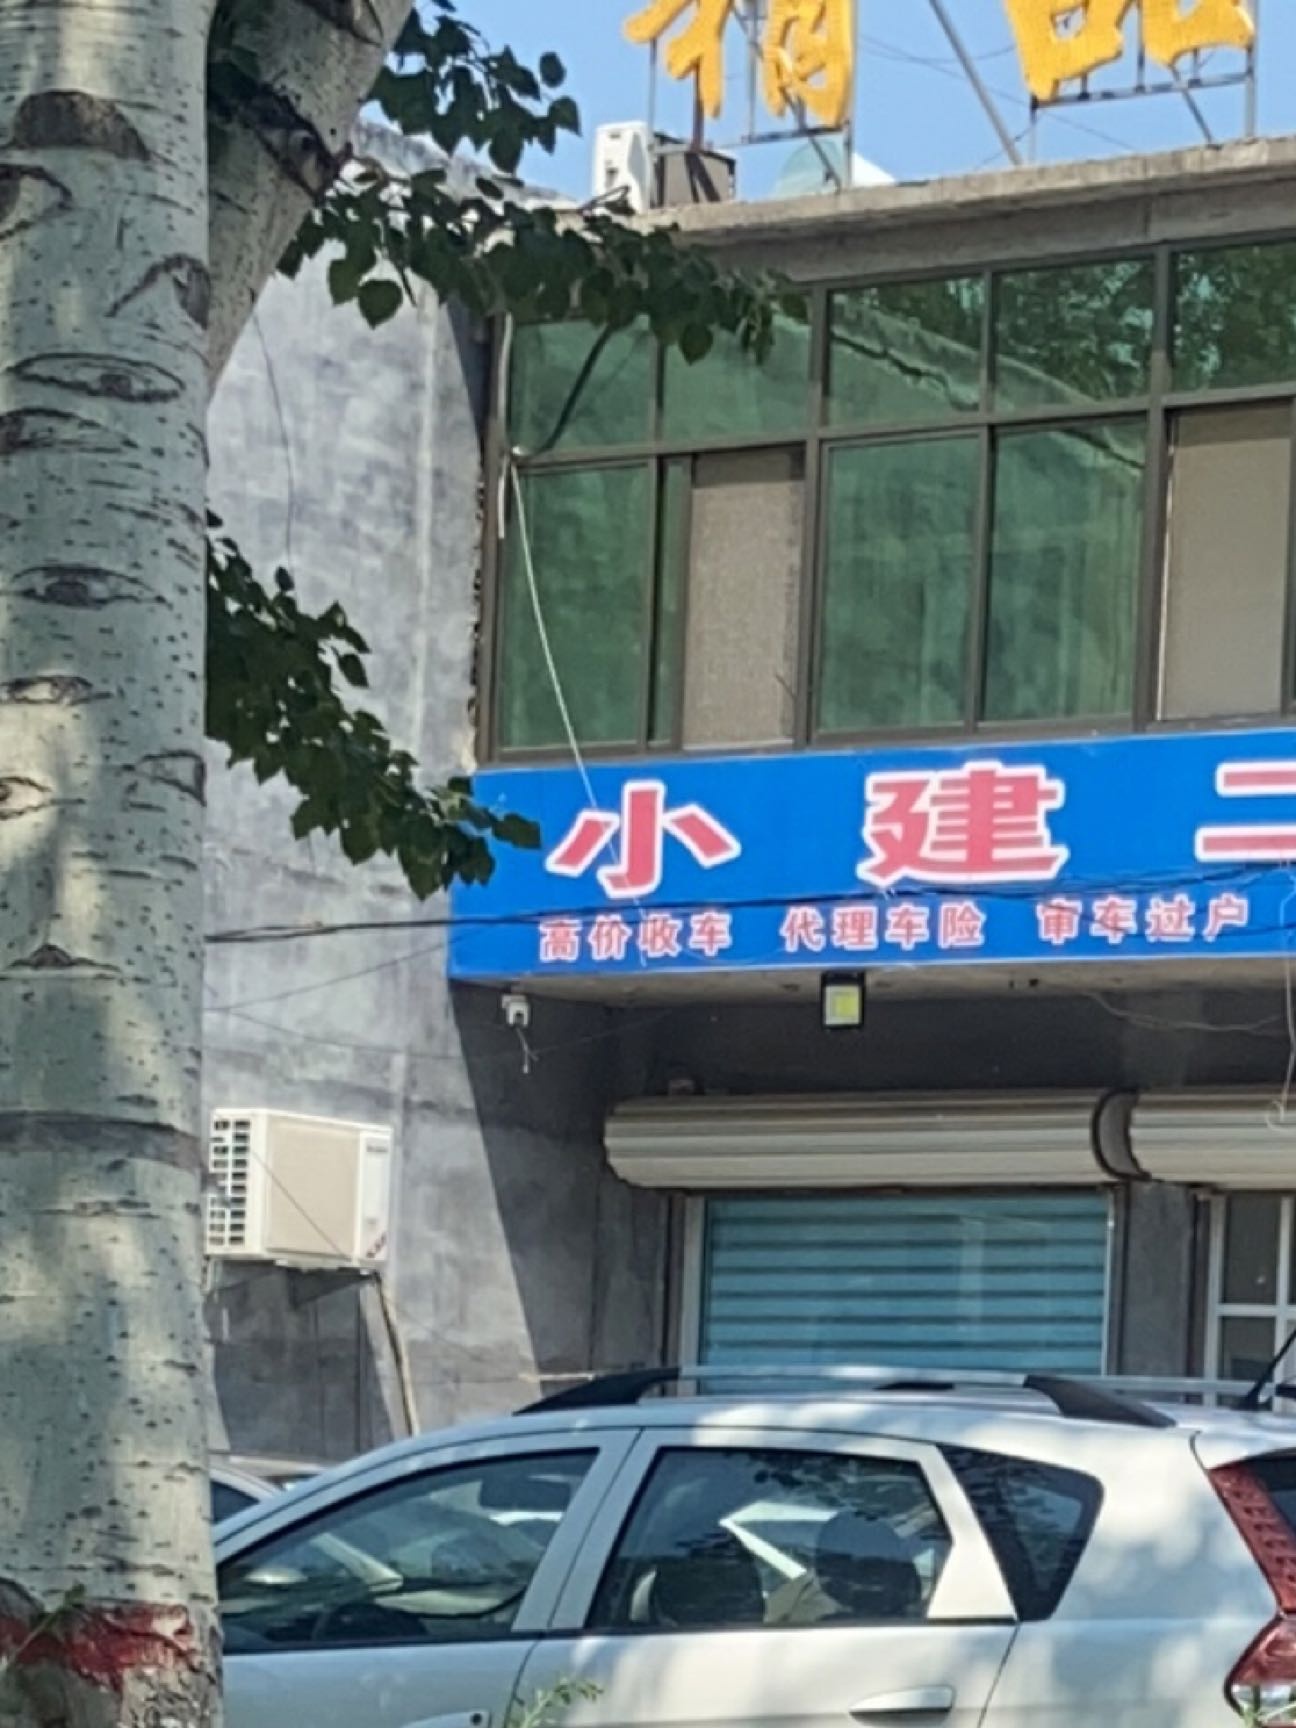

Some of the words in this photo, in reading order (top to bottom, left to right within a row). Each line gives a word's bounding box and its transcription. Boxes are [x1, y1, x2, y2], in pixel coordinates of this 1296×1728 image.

[538, 906, 733, 963] 高价收车
[780, 898, 987, 951] 代理车险
[1037, 892, 1249, 945] 审车过户
